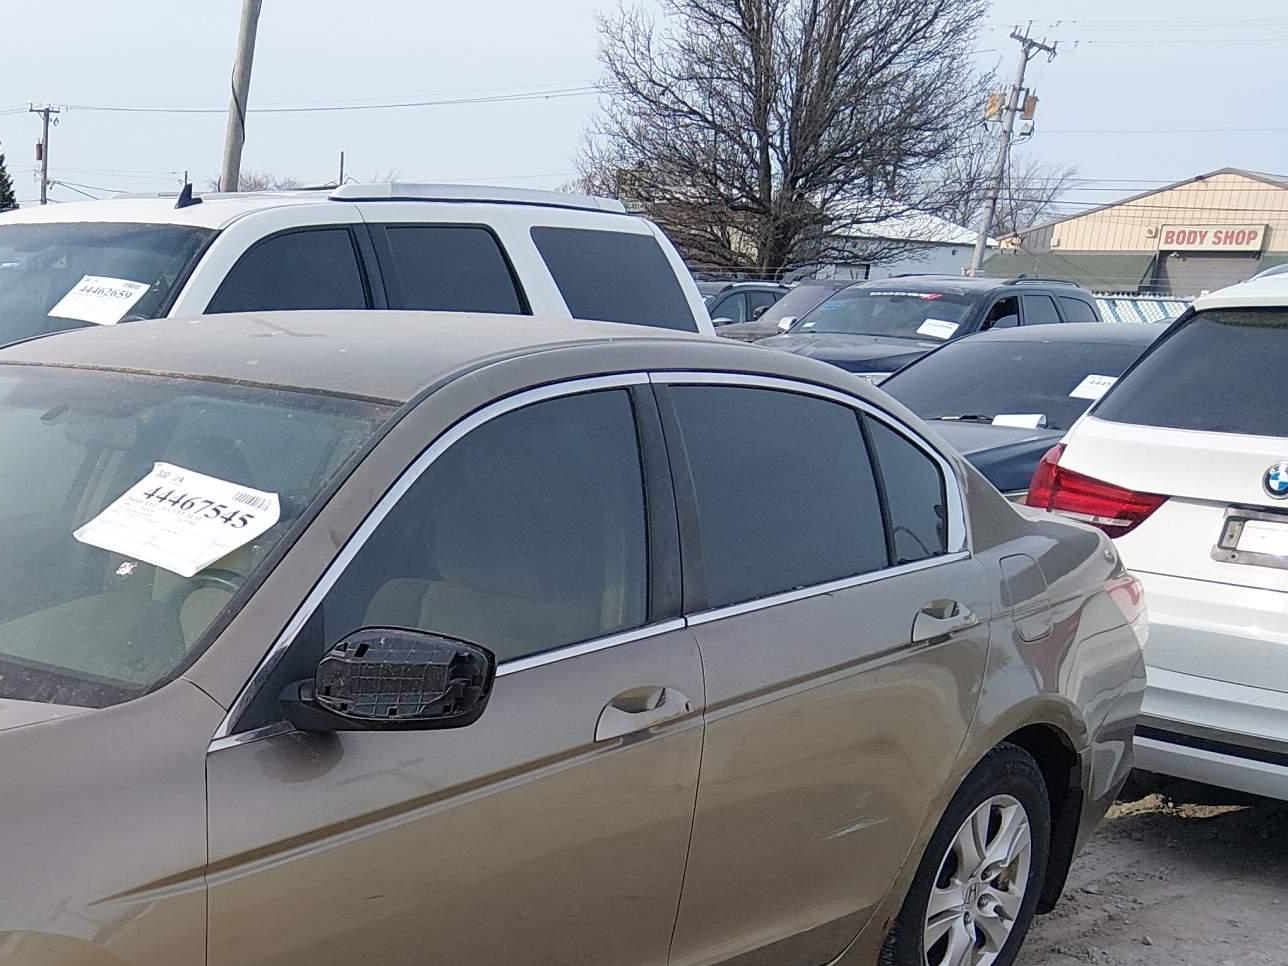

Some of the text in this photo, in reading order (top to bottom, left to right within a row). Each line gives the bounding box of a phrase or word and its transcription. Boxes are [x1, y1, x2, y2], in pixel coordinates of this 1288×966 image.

[1164, 229, 1258, 246] BODY SHOP
[79, 284, 133, 299] 44462659
[143, 486, 255, 529] 44467545
